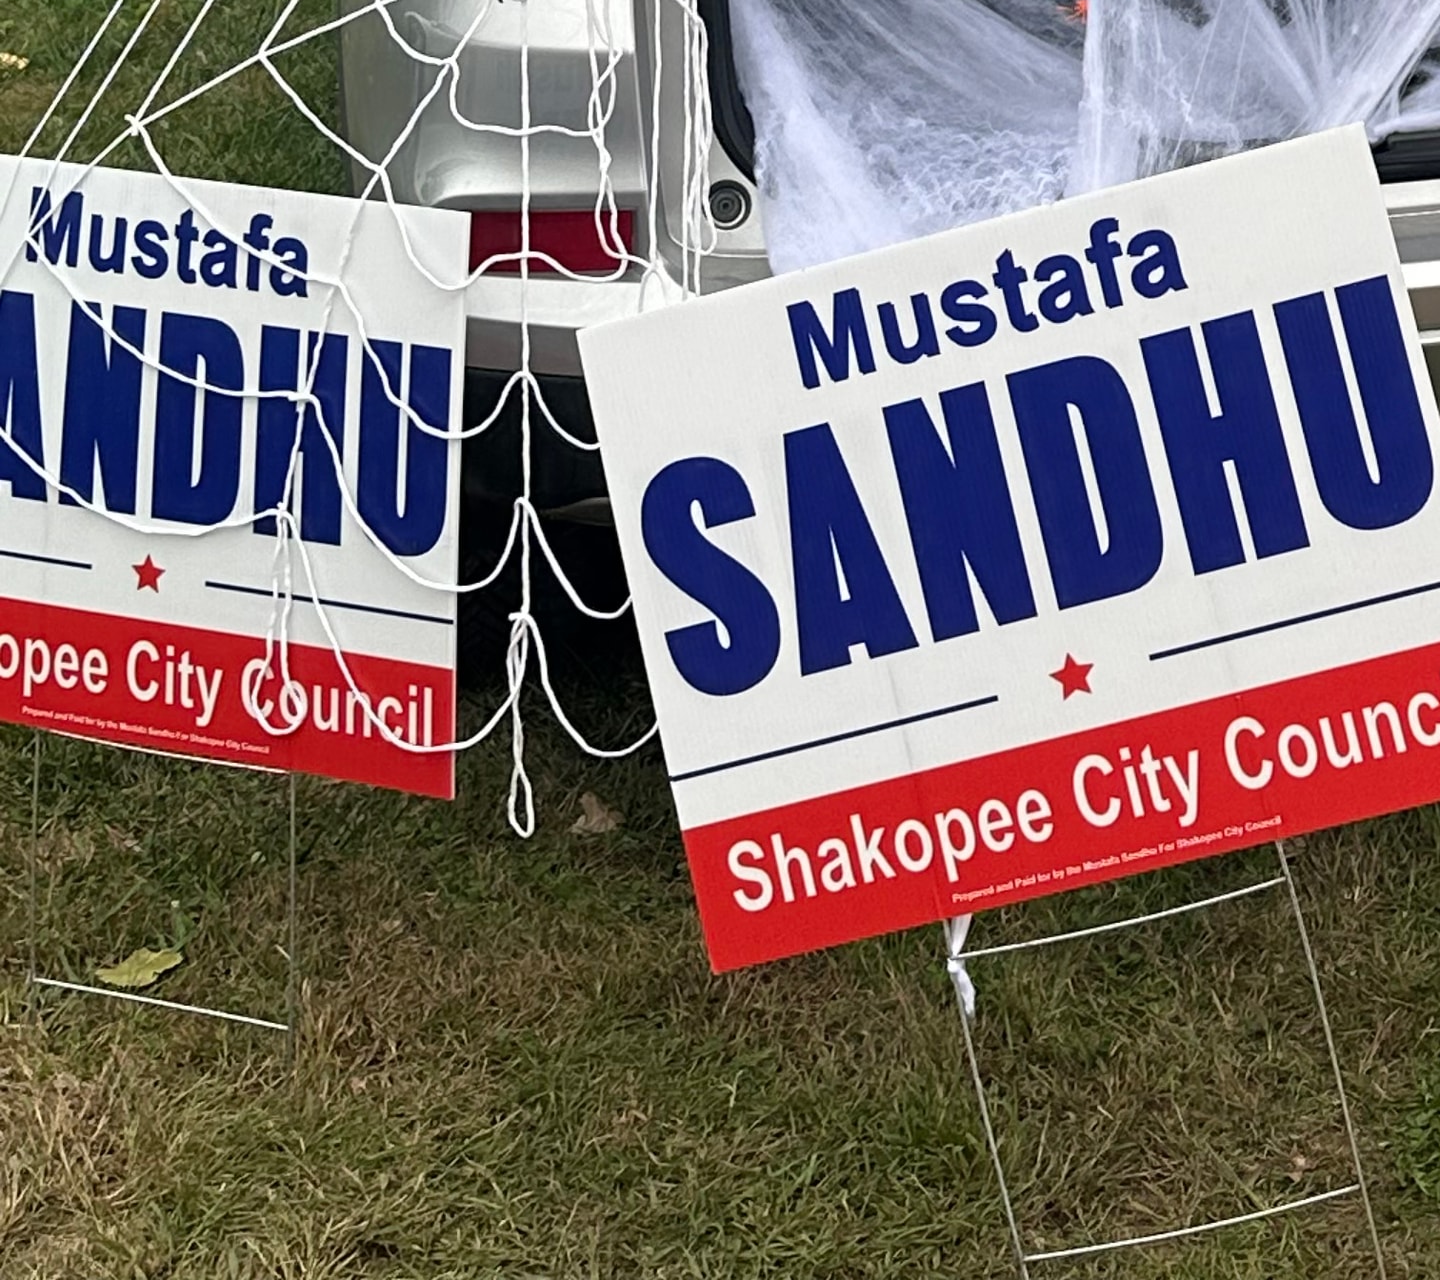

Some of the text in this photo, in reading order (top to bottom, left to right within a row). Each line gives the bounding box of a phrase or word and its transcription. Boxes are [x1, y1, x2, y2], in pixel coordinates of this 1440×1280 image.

[26, 186, 309, 298] Mustafa
[786, 217, 1190, 390] Mustafa
[640, 274, 1434, 697] SANDHU
[126, 639, 223, 727] City
[240, 657, 434, 747] Council
[727, 788, 1055, 912] Shakopee
[1073, 744, 1200, 827] City
[996, 881, 1014, 893] and
[1014, 874, 1037, 888] Paid
[1052, 869, 1065, 879] by
[1224, 826, 1243, 838] City
[1245, 815, 1282, 832] Council
